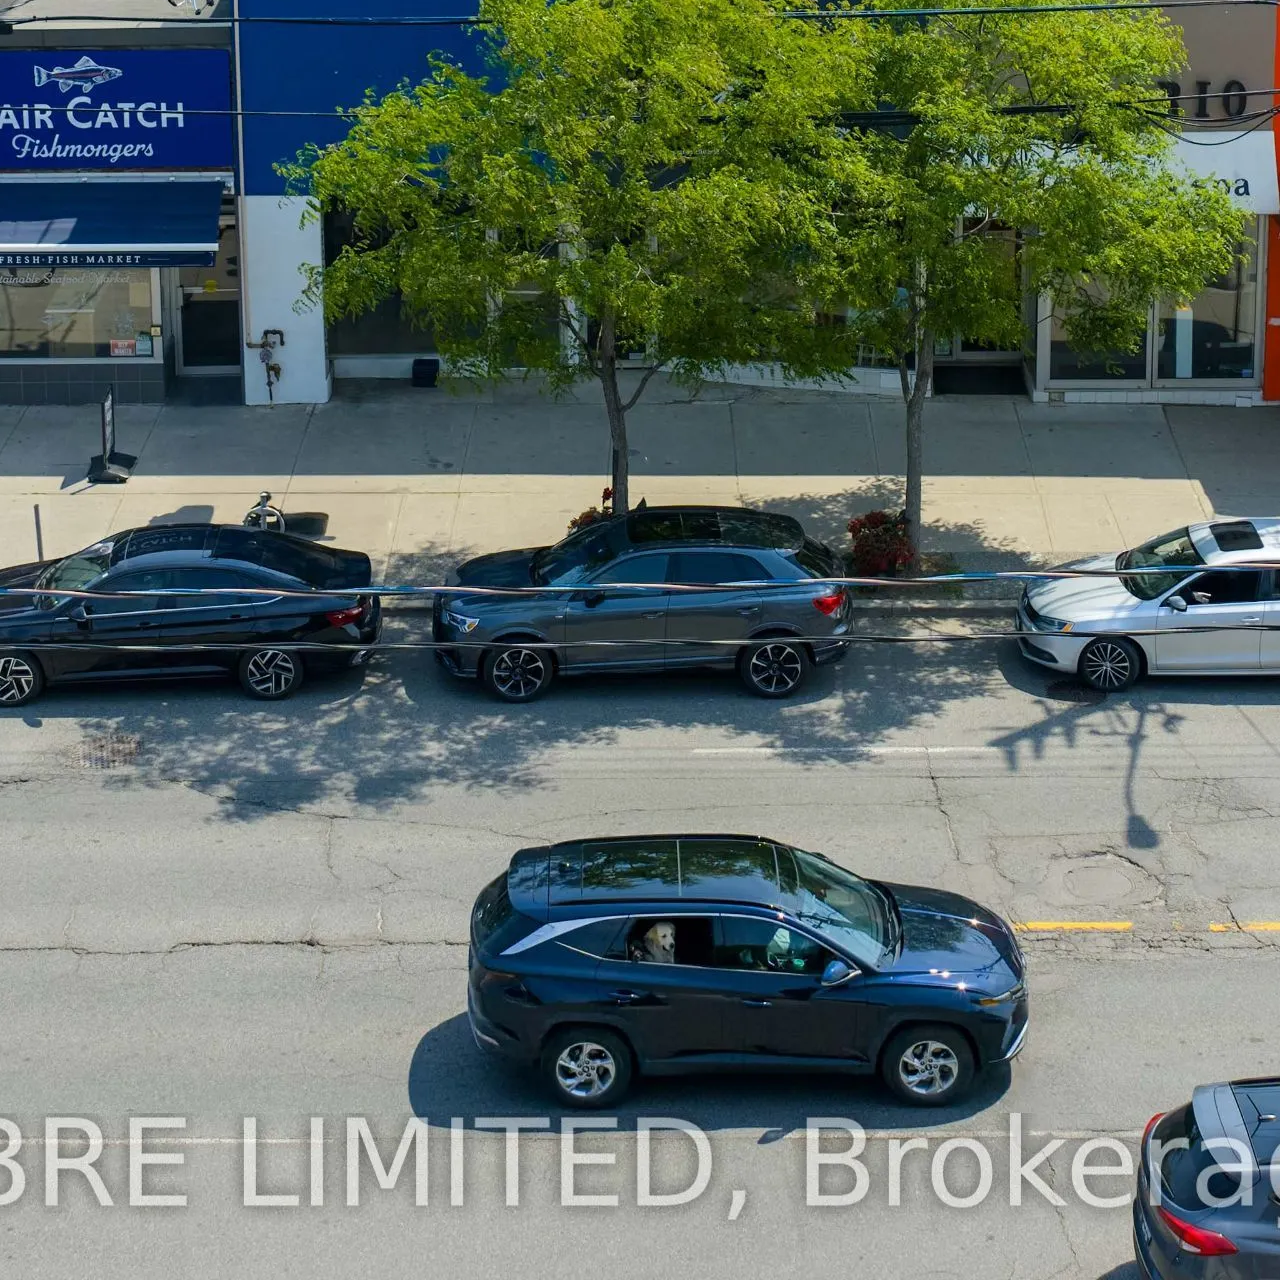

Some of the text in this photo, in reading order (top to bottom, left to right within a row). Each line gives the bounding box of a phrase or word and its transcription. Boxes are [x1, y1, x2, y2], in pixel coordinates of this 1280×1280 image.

[66, 96, 185, 129] CATCH
[11, 133, 154, 163] Fishmongers
[48, 256, 79, 264] FISH
[86, 255, 141, 263] MARKET
